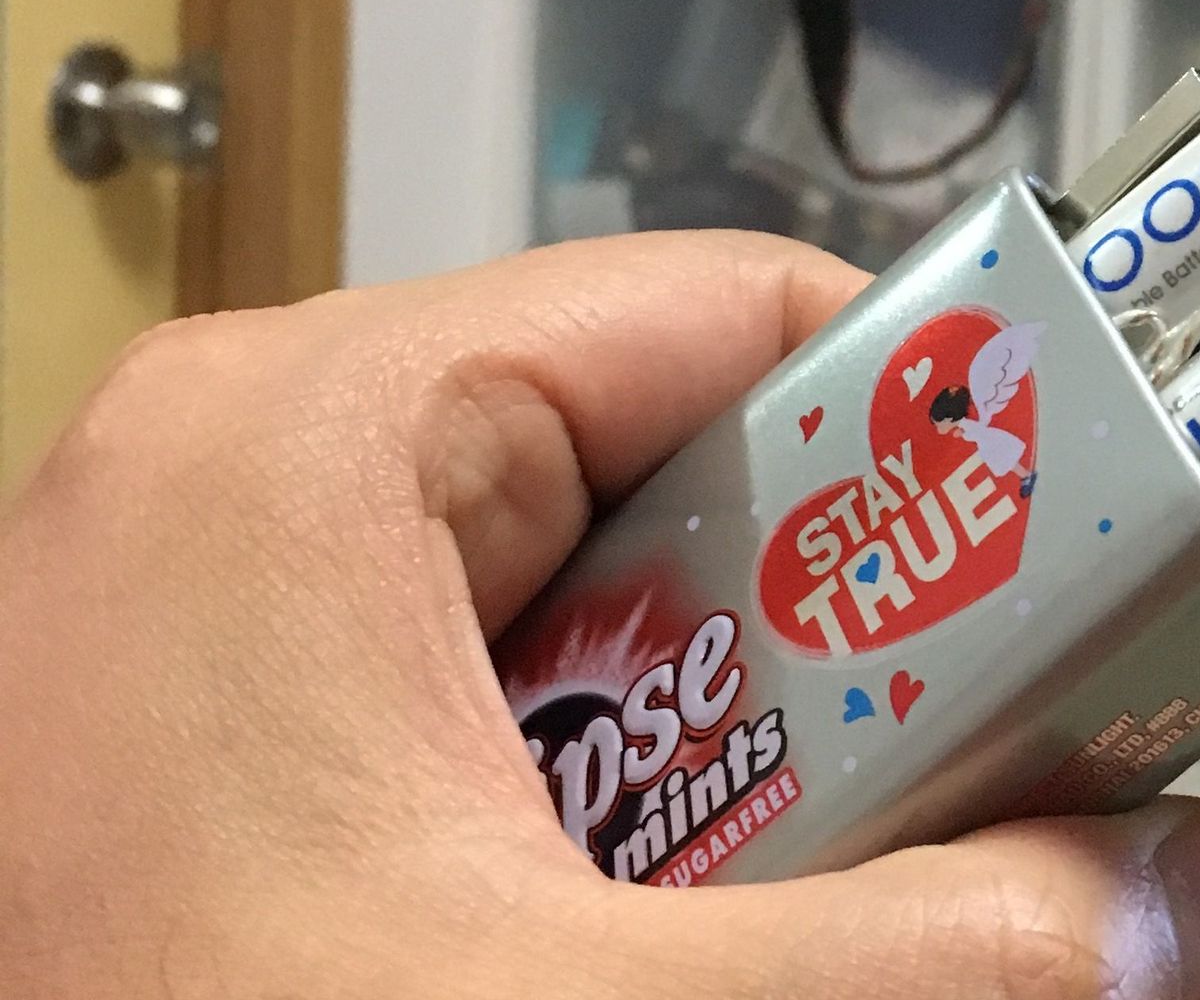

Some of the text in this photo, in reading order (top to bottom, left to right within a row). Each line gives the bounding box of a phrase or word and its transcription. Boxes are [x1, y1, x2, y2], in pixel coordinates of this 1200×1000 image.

[793, 453, 1019, 658] TRUE
[796, 438, 922, 577] STAY
[524, 612, 742, 861] pse
[613, 710, 786, 882] mints
